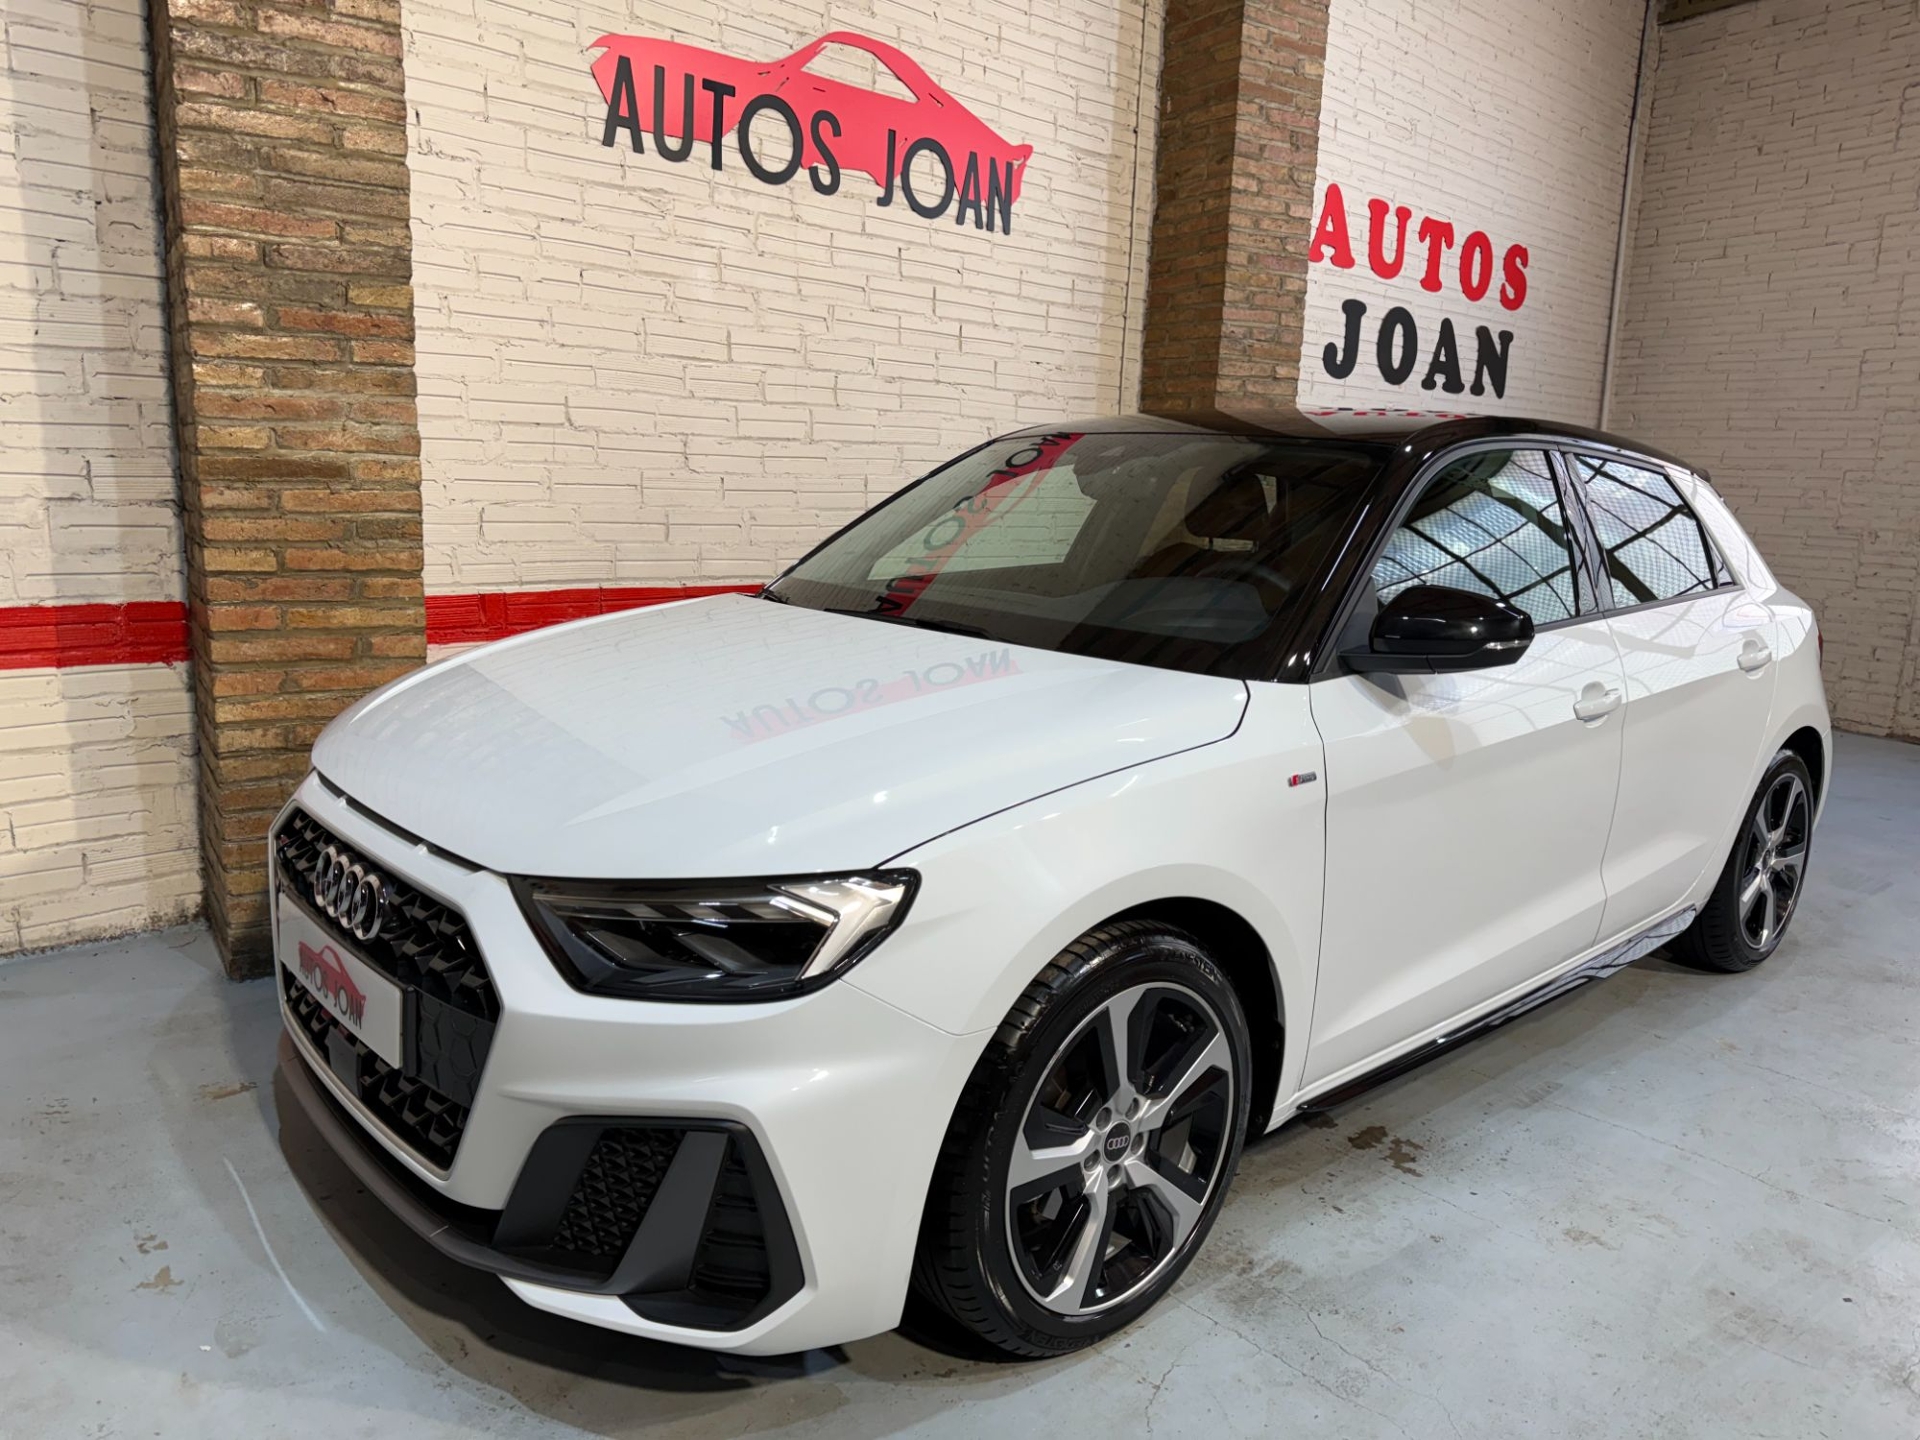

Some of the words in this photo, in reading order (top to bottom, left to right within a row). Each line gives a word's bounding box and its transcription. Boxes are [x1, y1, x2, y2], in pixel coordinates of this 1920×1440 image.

[602, 55, 841, 196] AUTOS
[876, 128, 1013, 236] JOAN
[1308, 183, 1529, 311] AUTOS
[1322, 299, 1514, 400] JOAN
[300, 947, 329, 999] AUTOS
[334, 979, 363, 1030] JOAN
